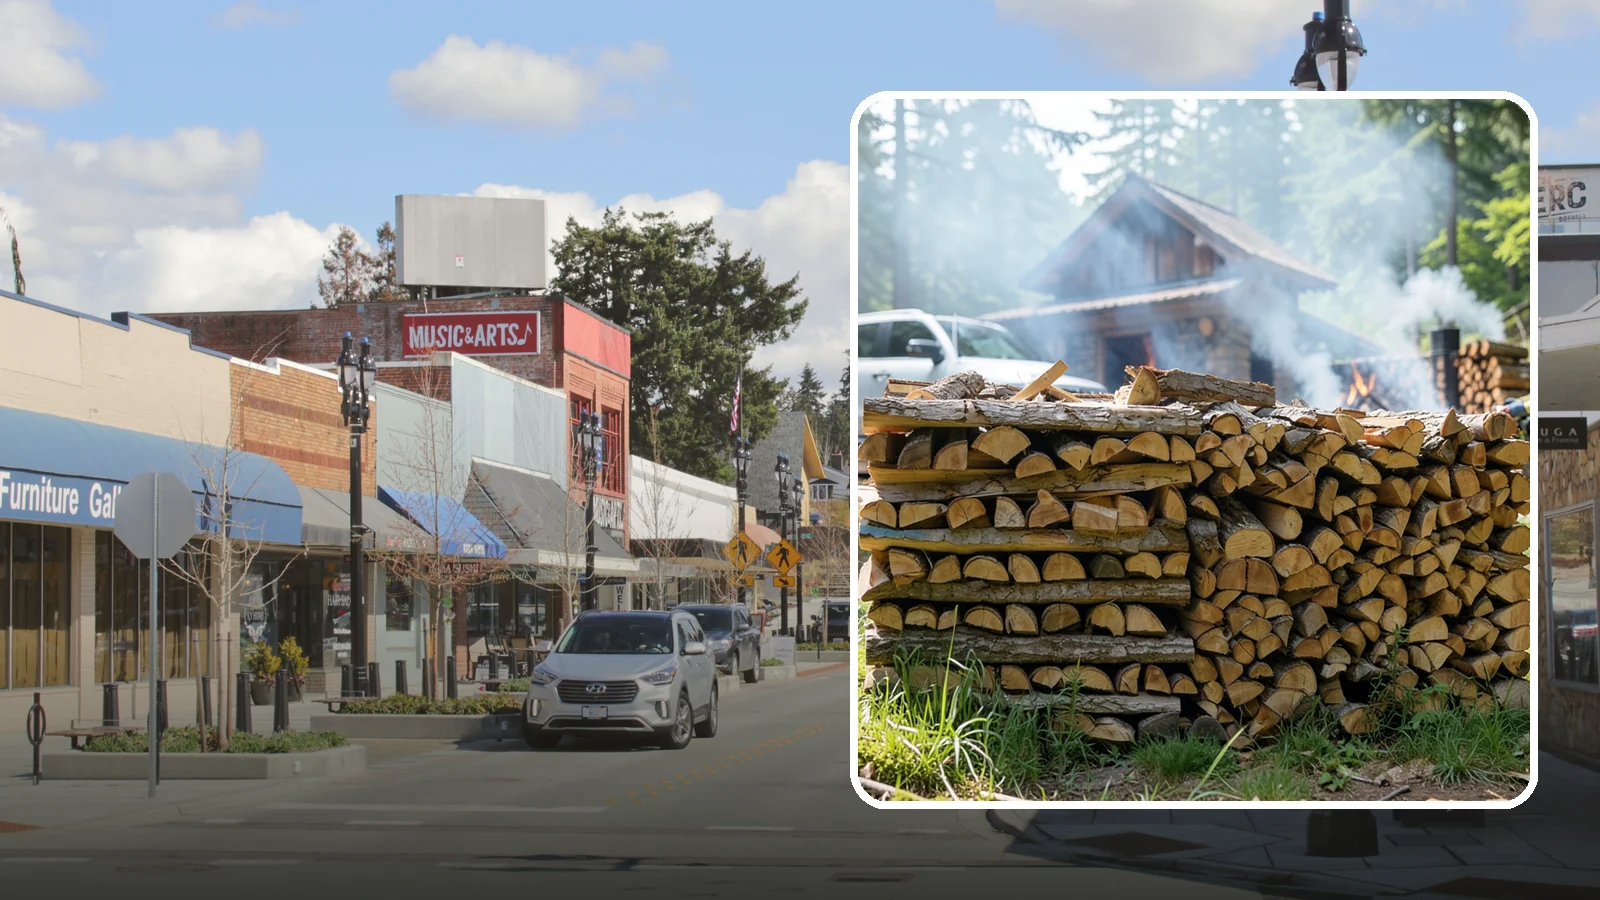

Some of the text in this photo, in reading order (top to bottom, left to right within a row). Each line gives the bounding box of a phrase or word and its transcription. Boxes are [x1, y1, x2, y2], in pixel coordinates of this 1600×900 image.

[1540, 428, 1577, 437] UGA
[0, 472, 122, 519] Furniture Gal
